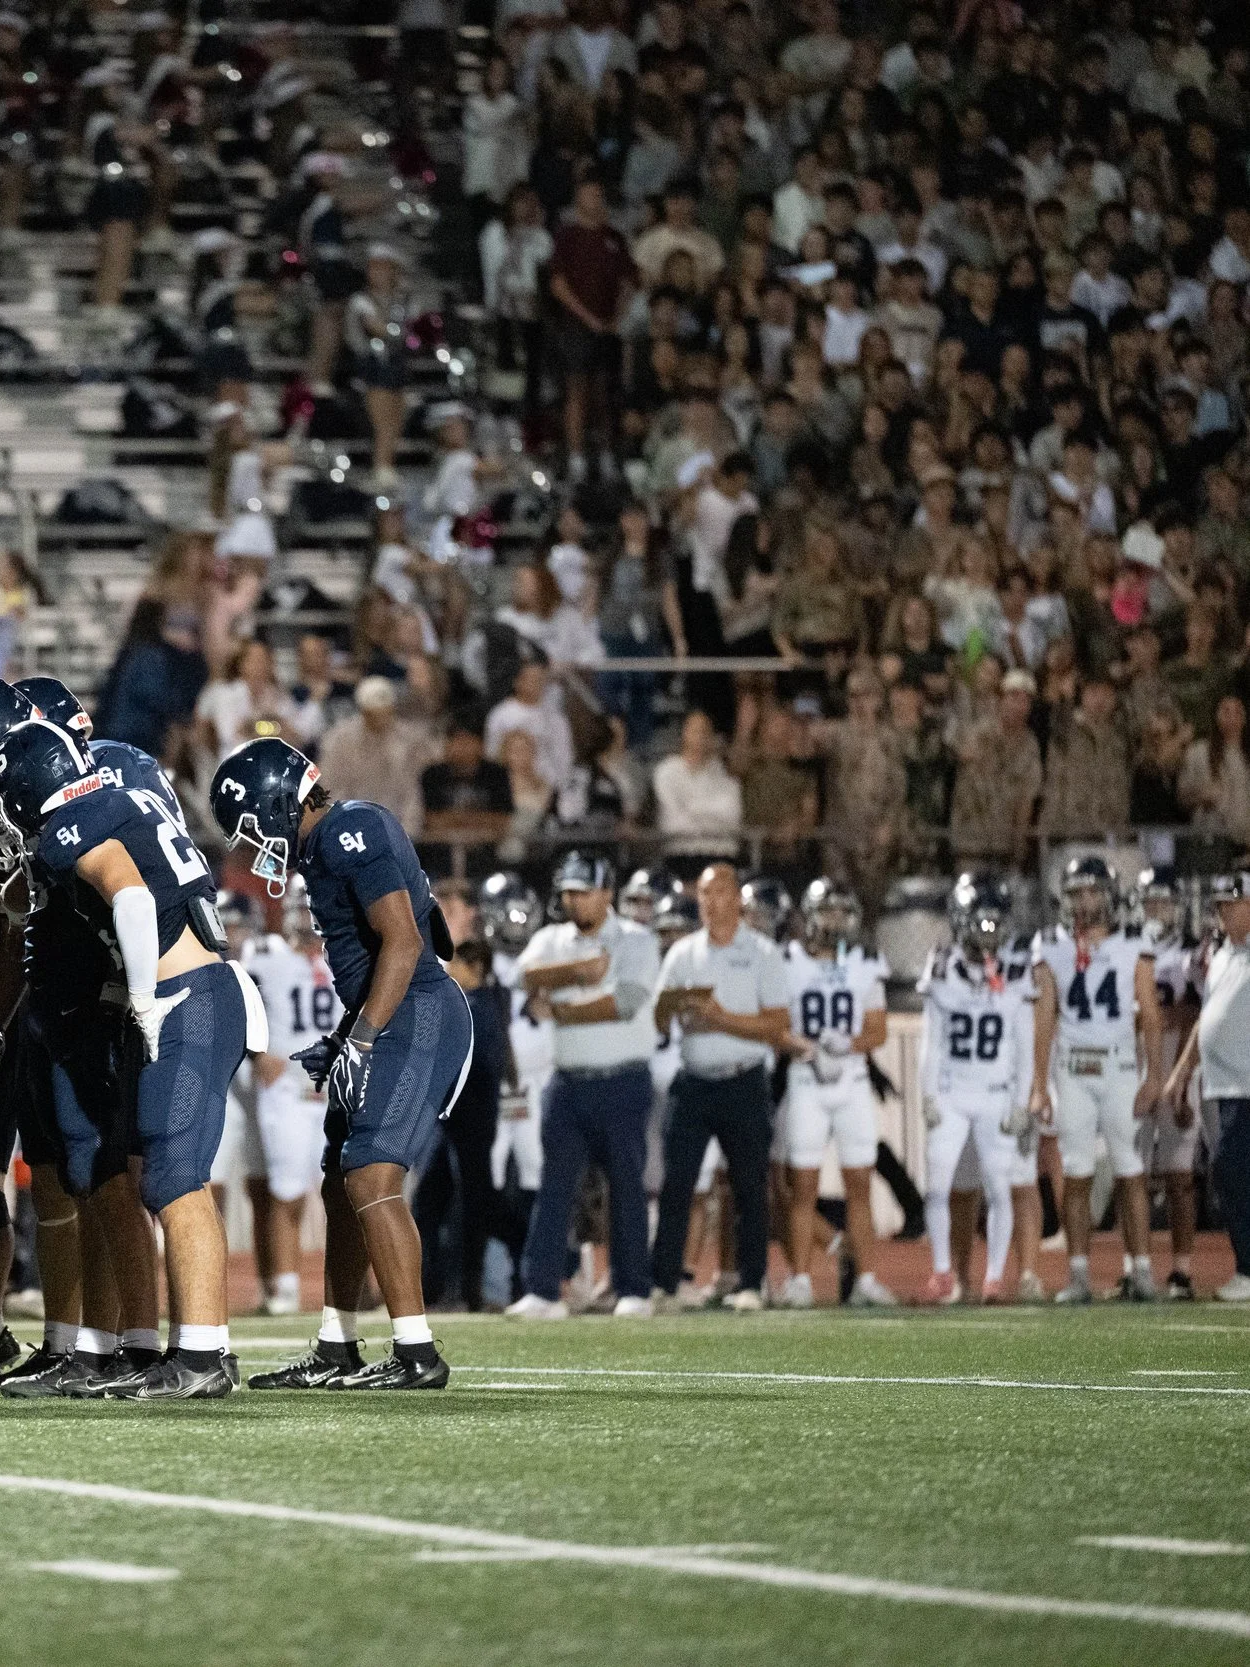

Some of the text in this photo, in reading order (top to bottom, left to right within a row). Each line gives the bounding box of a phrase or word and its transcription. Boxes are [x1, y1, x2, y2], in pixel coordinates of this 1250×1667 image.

[62, 775, 101, 801] Riddell
[221, 777, 246, 802] 3
[56, 824, 82, 845] SV
[339, 831, 367, 853] SV
[290, 986, 334, 1032] 18
[1067, 970, 1121, 1020] 44
[801, 990, 853, 1040] 88
[950, 1012, 1003, 1060] 28
